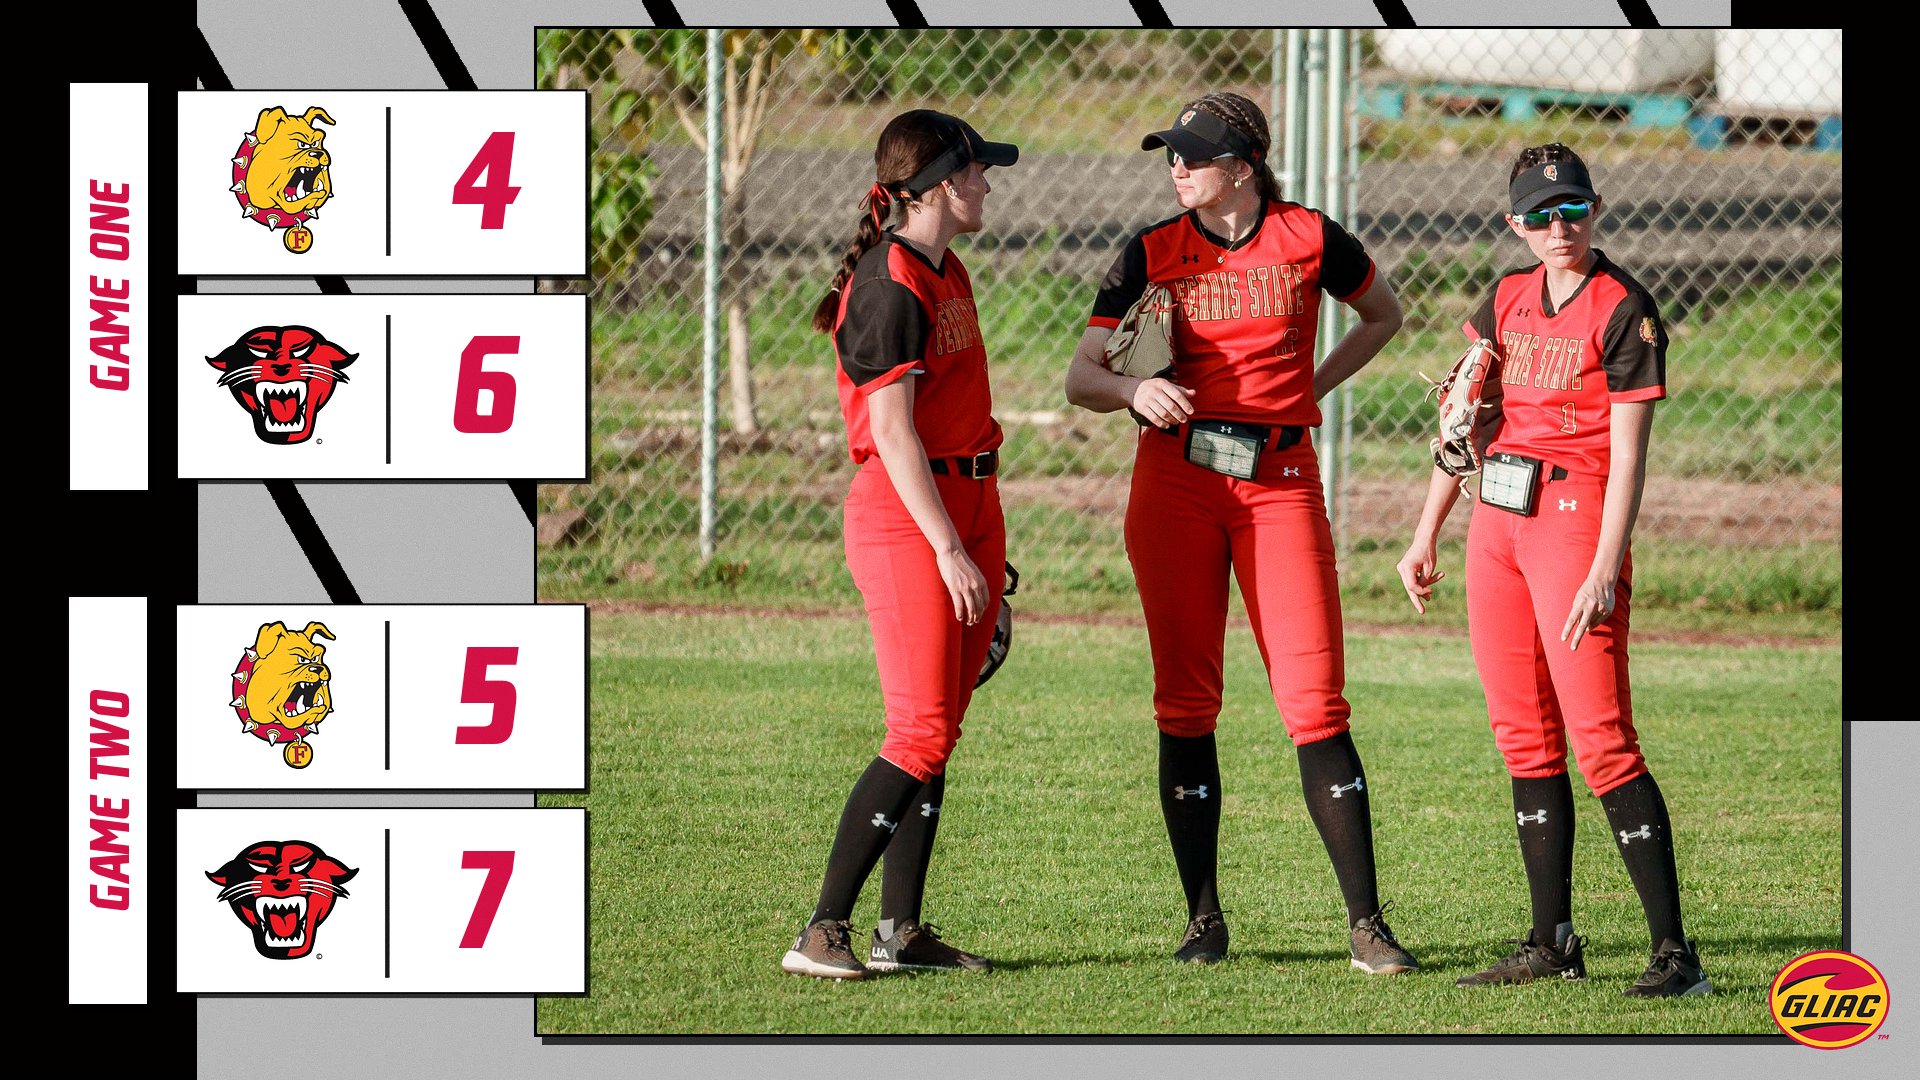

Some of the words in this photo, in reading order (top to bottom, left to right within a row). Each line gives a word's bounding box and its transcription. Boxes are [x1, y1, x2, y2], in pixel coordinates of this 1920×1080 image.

[1175, 271, 1241, 322] FERRIS
[1246, 264, 1304, 318] STATE
[1534, 337, 1584, 391] STATE
[1560, 402, 1577, 435] 1
[871, 946, 890, 960] UA
